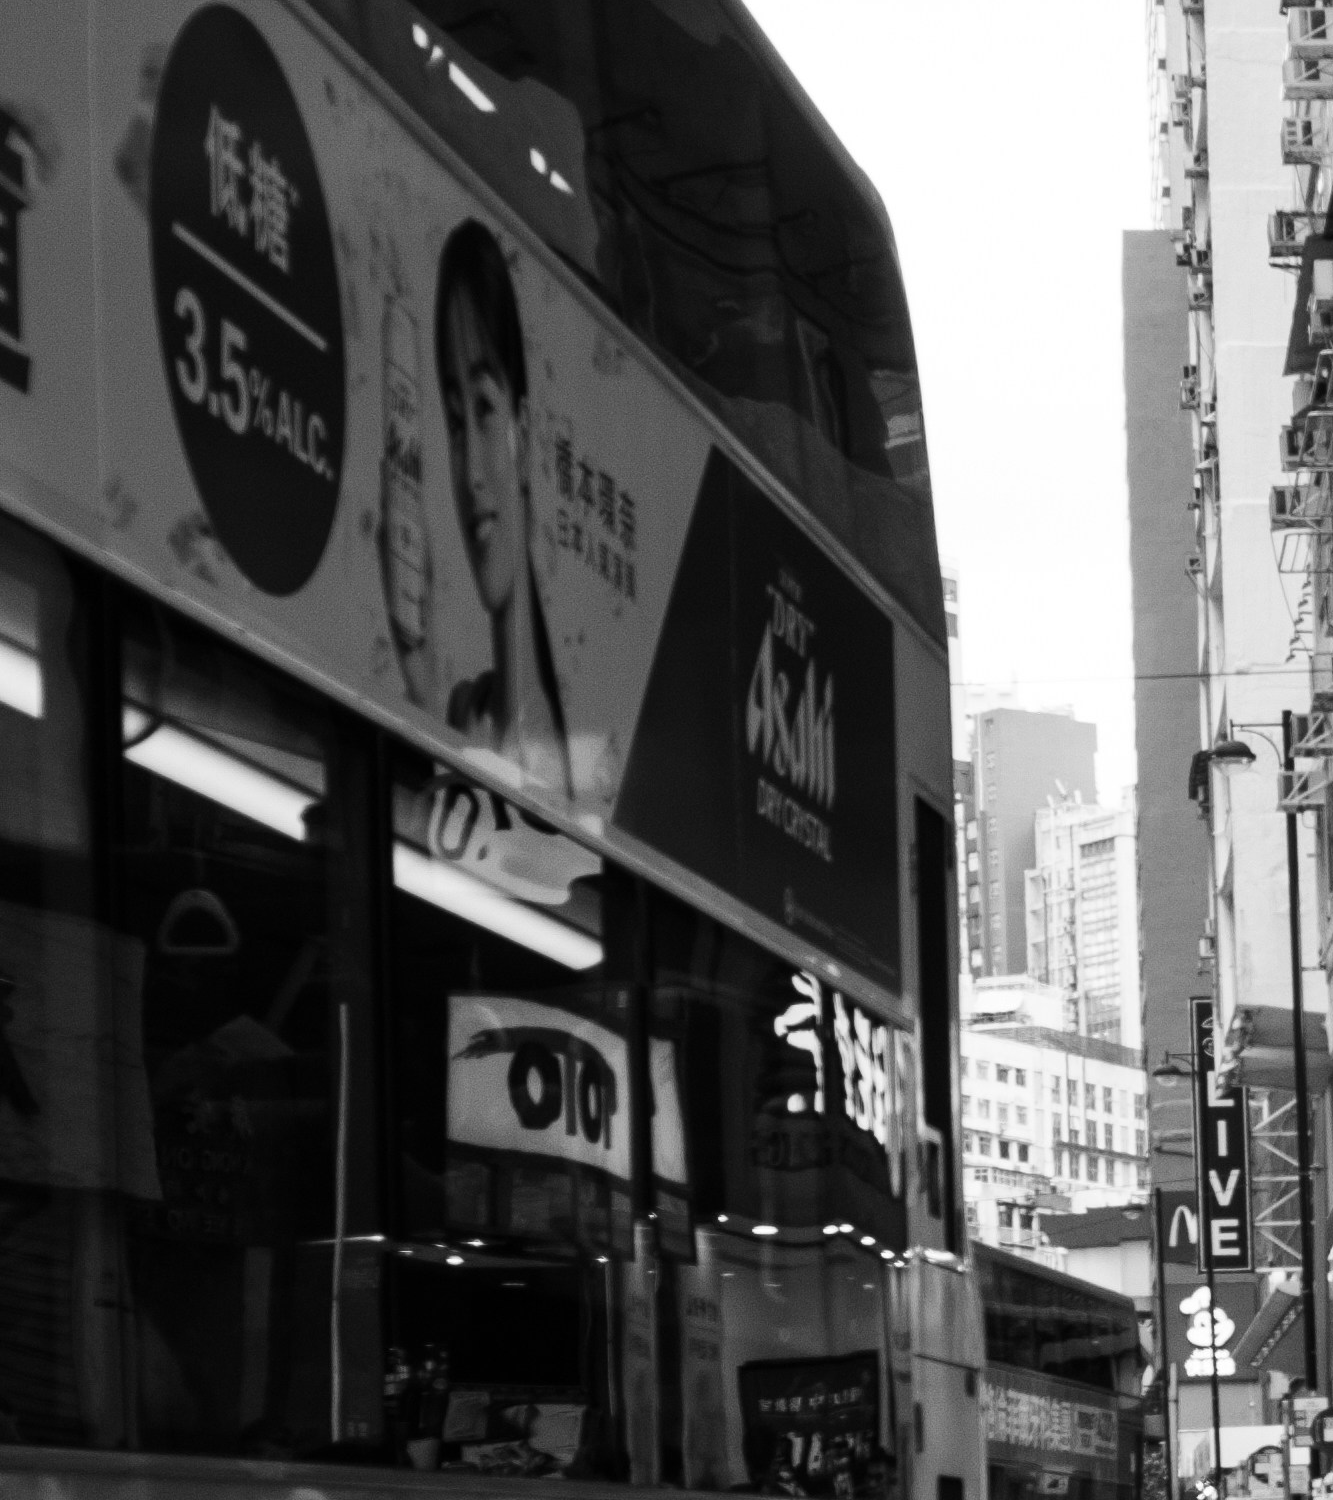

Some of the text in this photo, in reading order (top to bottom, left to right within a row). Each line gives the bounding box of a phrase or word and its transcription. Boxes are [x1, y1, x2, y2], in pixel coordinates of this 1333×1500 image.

[204, 103, 293, 276] 低糖
[746, 619, 836, 812] Asahi
[1206, 1070, 1242, 1257] LIVE
